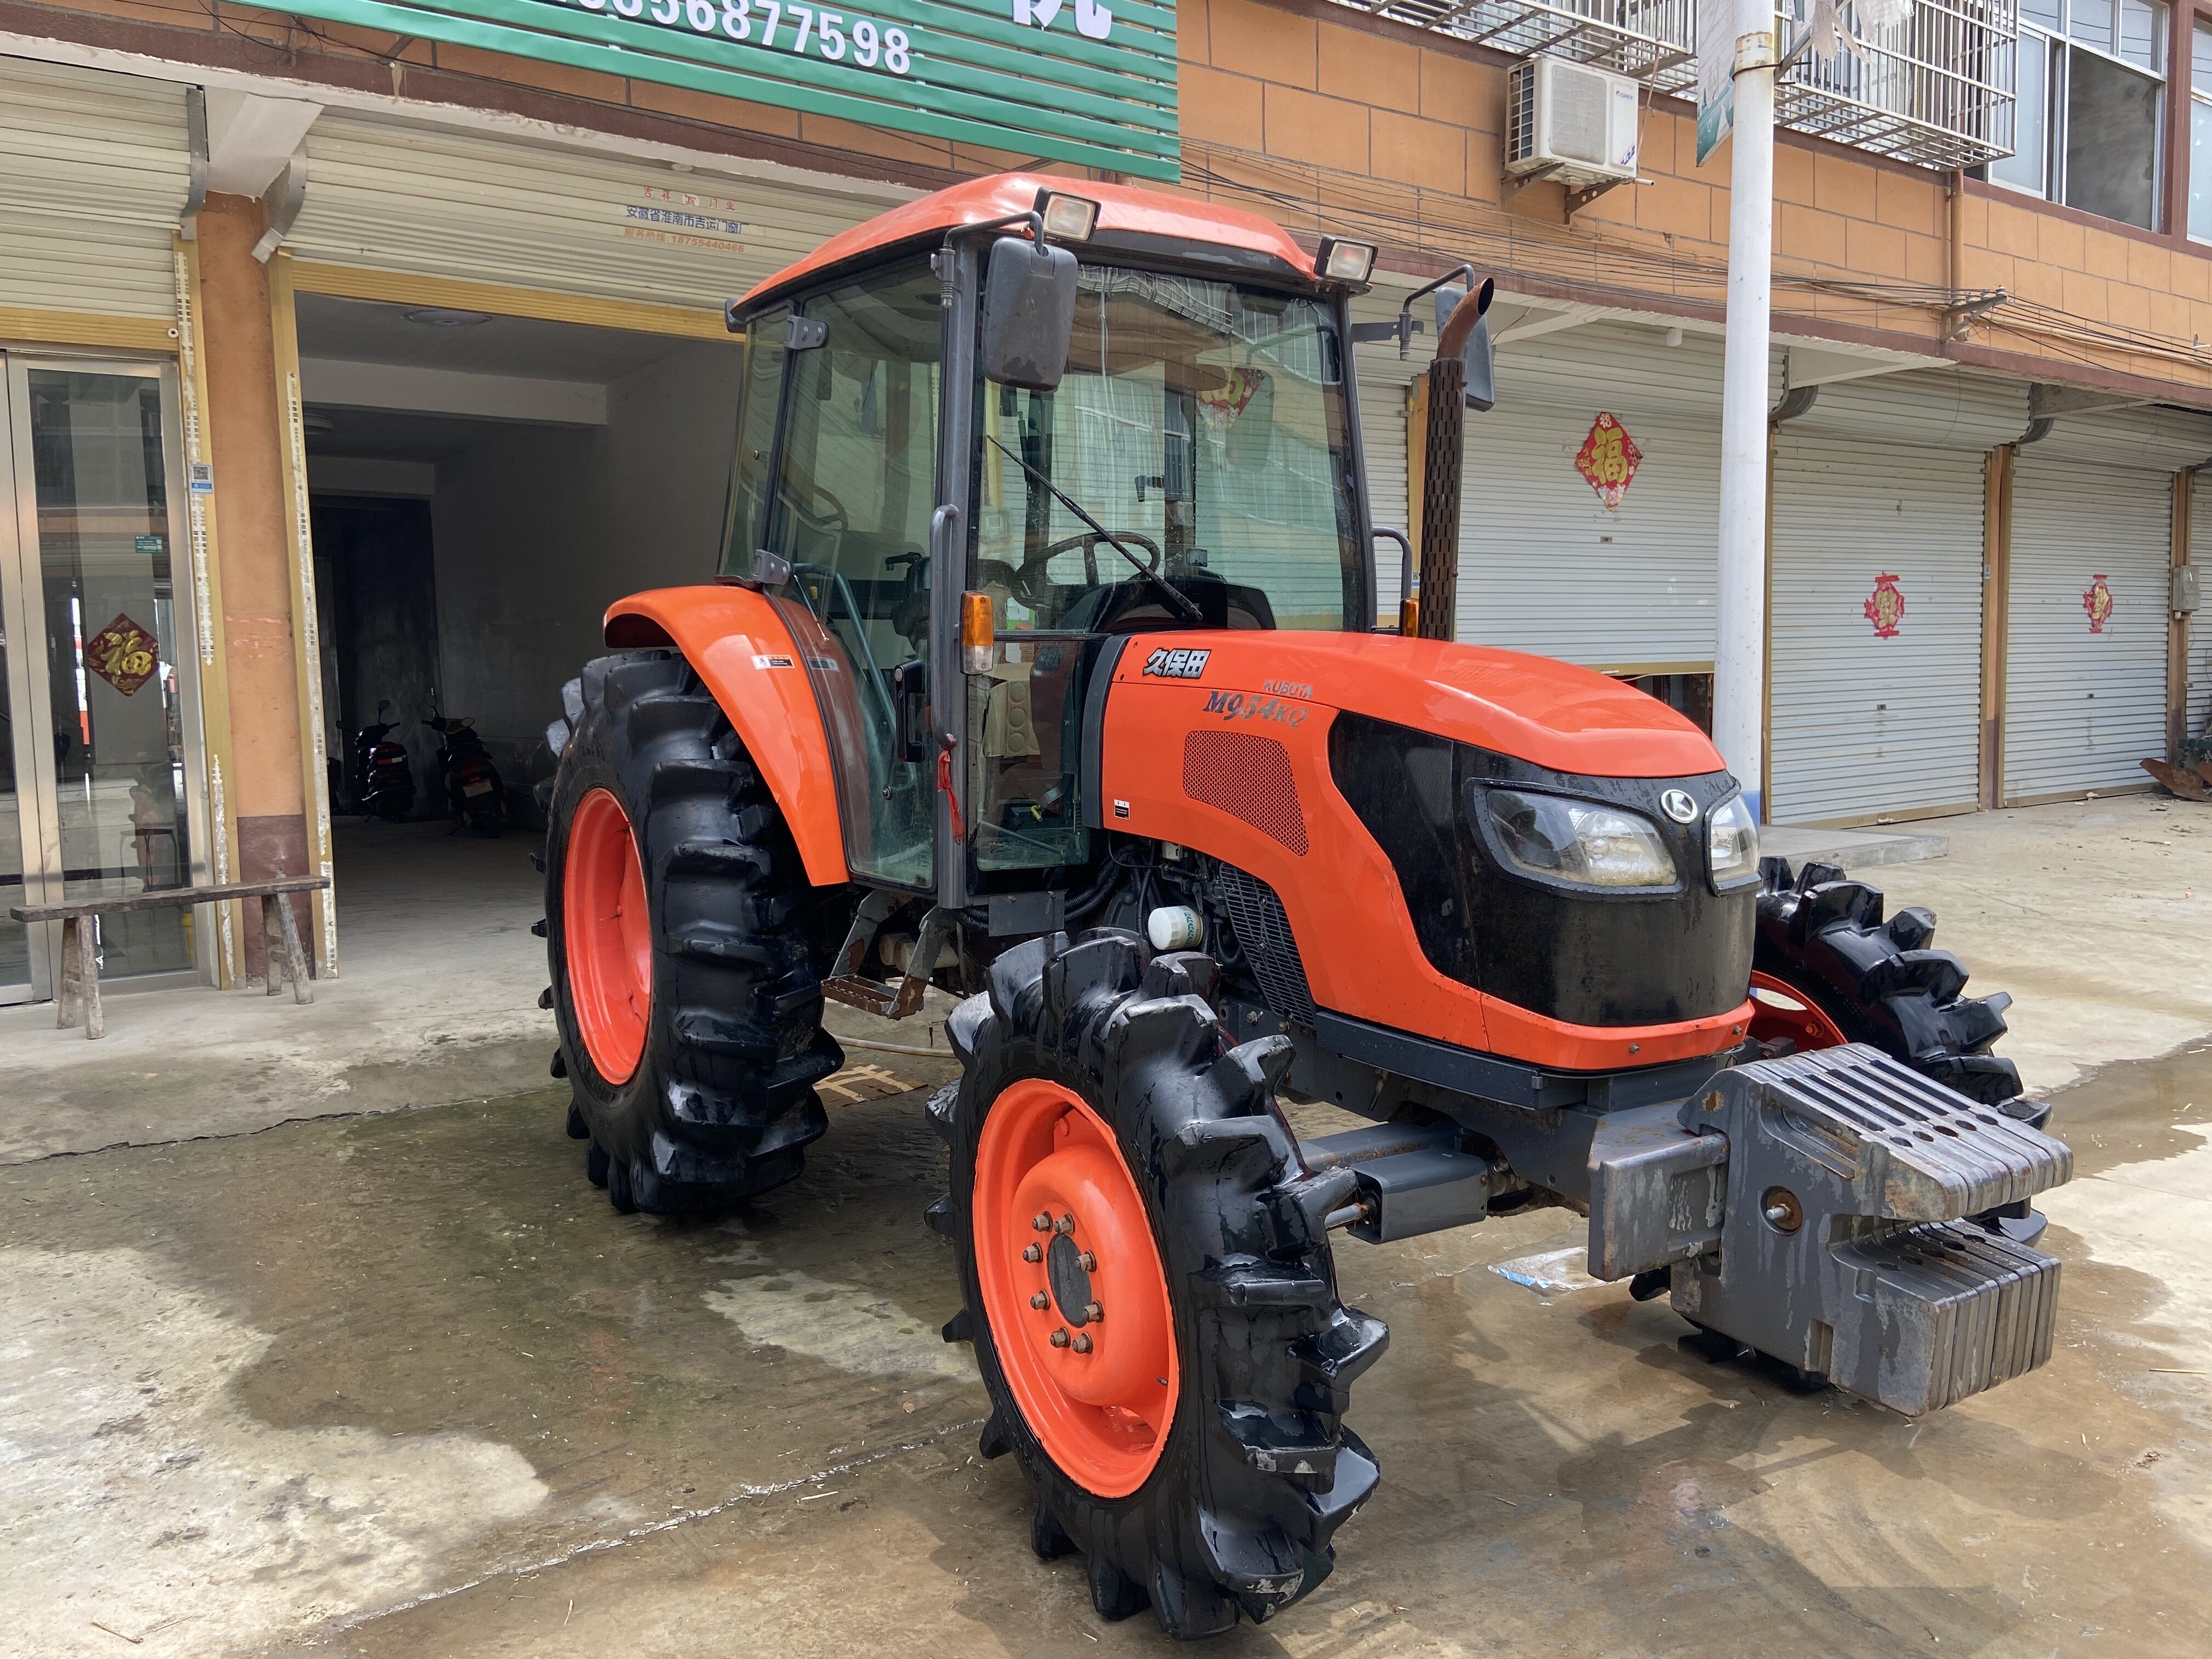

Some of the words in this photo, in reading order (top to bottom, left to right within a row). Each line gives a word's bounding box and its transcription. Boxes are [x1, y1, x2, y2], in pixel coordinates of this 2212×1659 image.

[556, 0, 911, 74] 56877598
[1591, 426, 1628, 485] 福
[100, 630, 153, 676] 福
[1143, 647, 1211, 679] 久保田
[1202, 690, 1308, 728] M954KQ
[1263, 679, 1313, 699] KUBOTA
